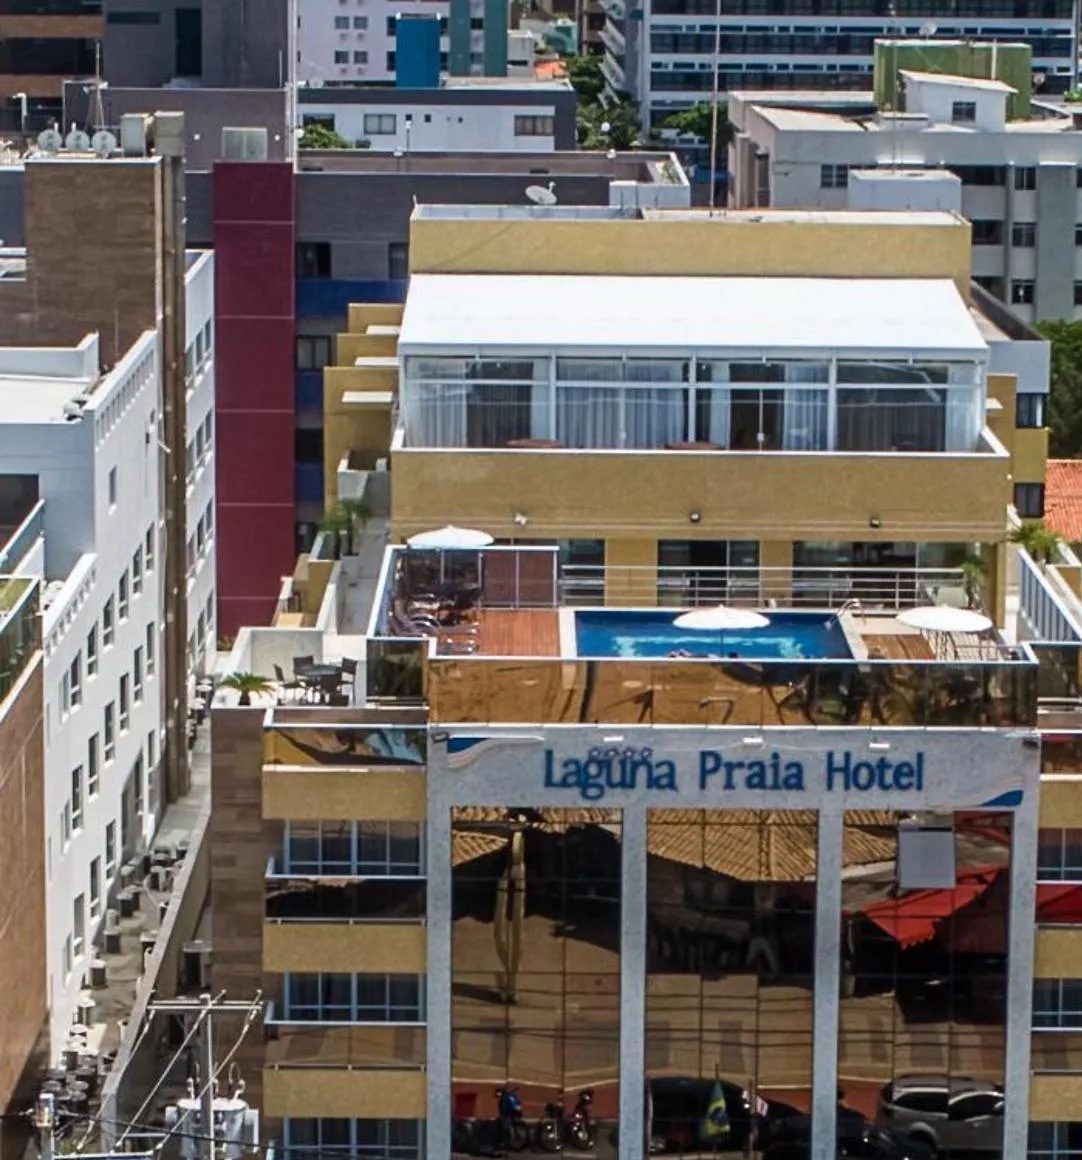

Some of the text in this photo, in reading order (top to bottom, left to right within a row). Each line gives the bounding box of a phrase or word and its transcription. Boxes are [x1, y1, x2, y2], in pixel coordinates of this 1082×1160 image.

[544, 749, 924, 800] Laguna Praia Hotel
